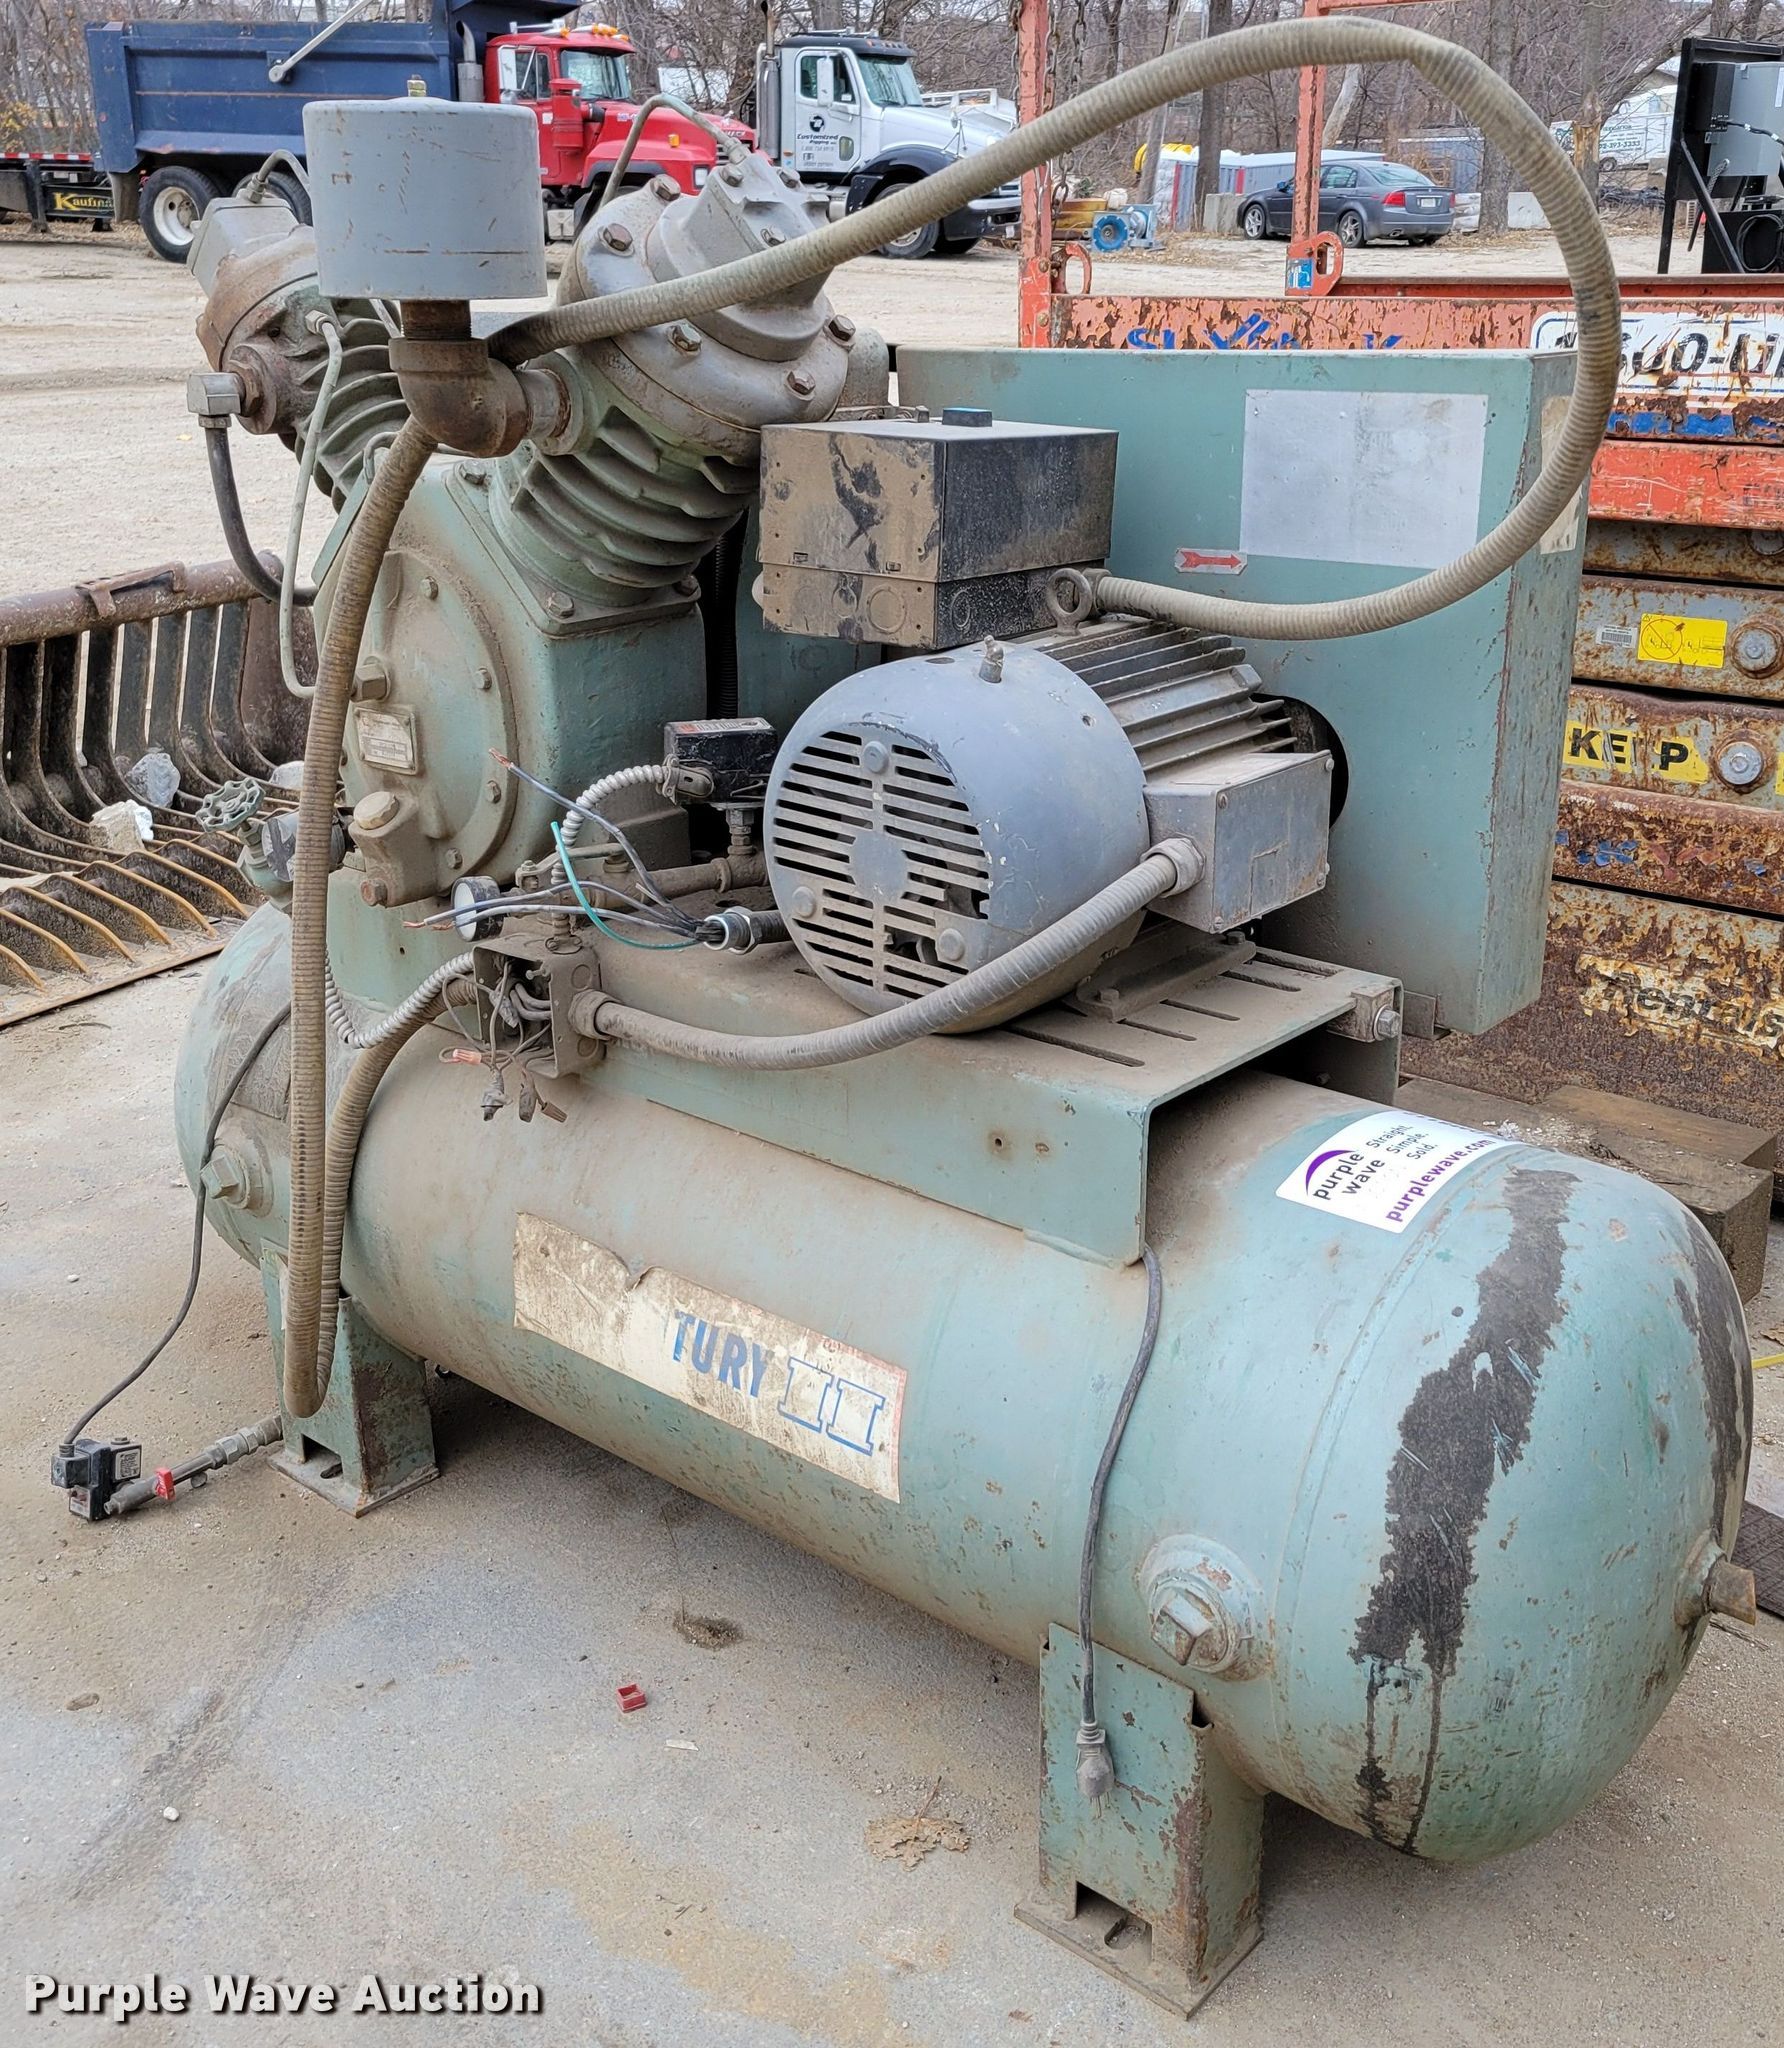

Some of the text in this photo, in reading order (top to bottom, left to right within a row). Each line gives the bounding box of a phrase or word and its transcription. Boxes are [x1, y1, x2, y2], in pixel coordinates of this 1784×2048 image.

[1570, 728, 1689, 771] KEP
[1365, 1125, 1414, 1149] Straight.
[1386, 1132, 1429, 1154] Simple.
[1406, 1144, 1439, 1160] Sold.
[1313, 1151, 1365, 1201] purple
[1342, 1158, 1386, 1195] wave
[1385, 1138, 1496, 1222] purplewave.com
